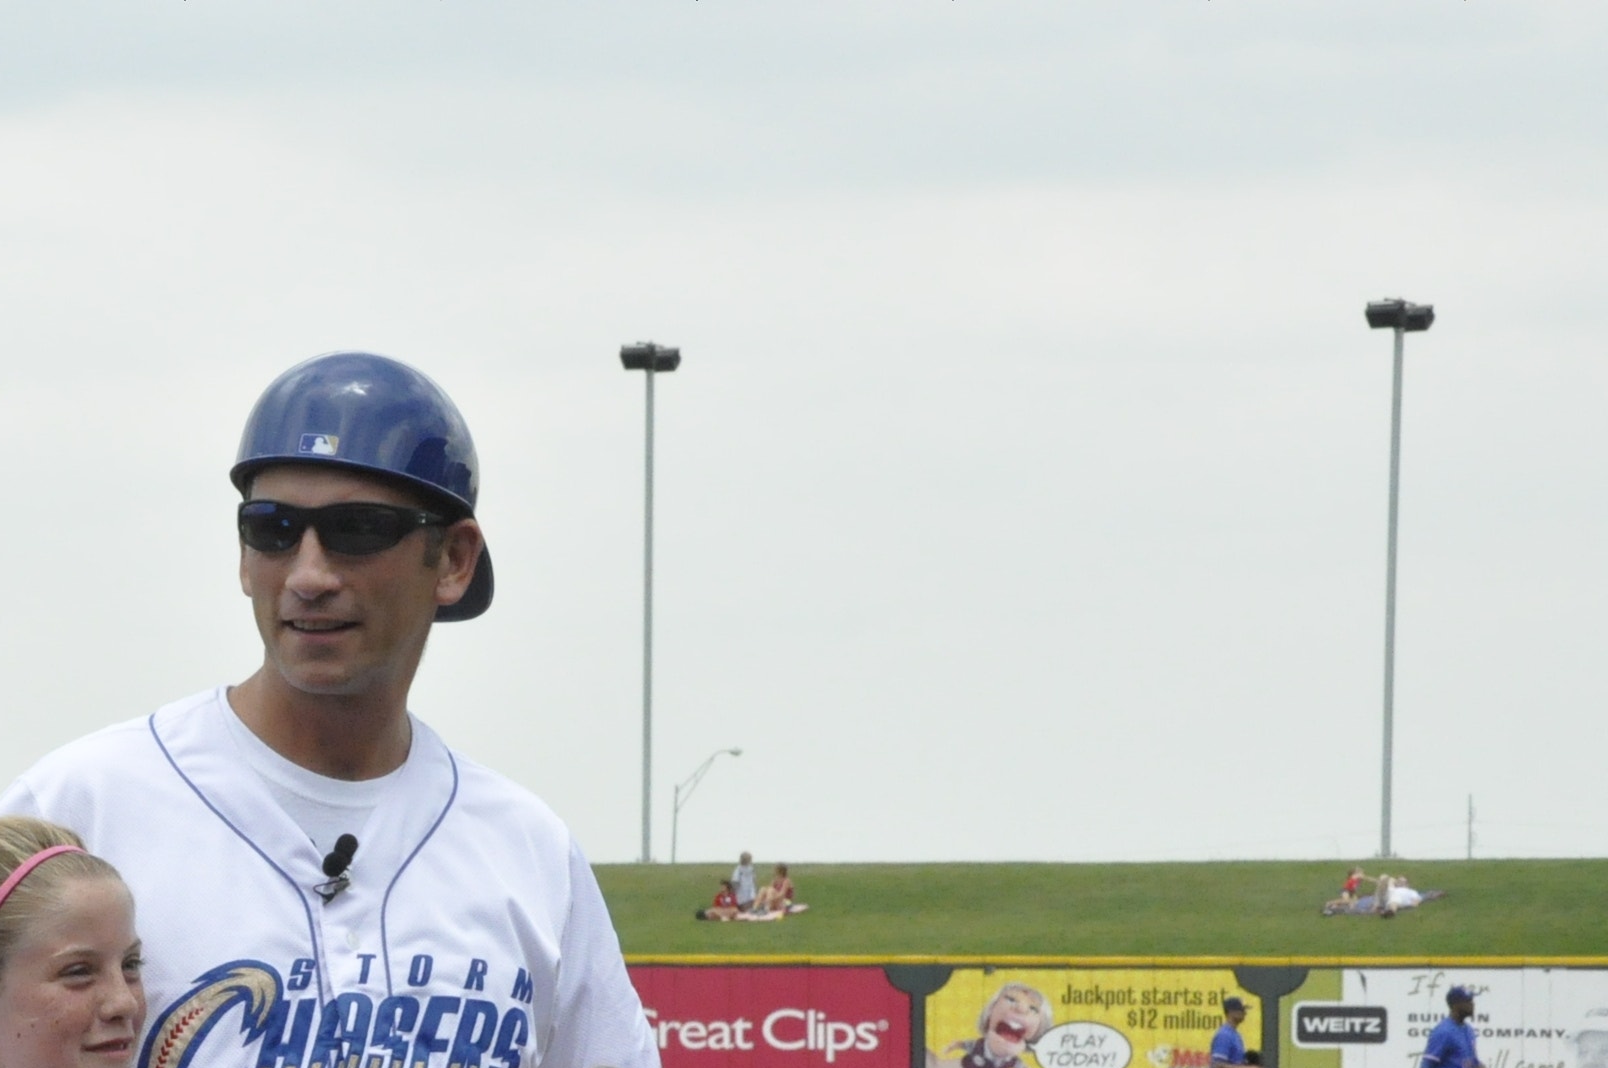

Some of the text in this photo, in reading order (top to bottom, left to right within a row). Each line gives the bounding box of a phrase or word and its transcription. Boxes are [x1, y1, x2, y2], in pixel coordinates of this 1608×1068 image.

[288, 953, 533, 1004] STORM
[1061, 984, 1228, 1010] Jackpot starts at
[1127, 1008, 1158, 1030] $12
[1303, 1016, 1381, 1034] WEITZ
[1408, 1013, 1444, 1023] BUI
[1060, 1034, 1107, 1049] PLAY
[1047, 1052, 1117, 1067] TODAY!
